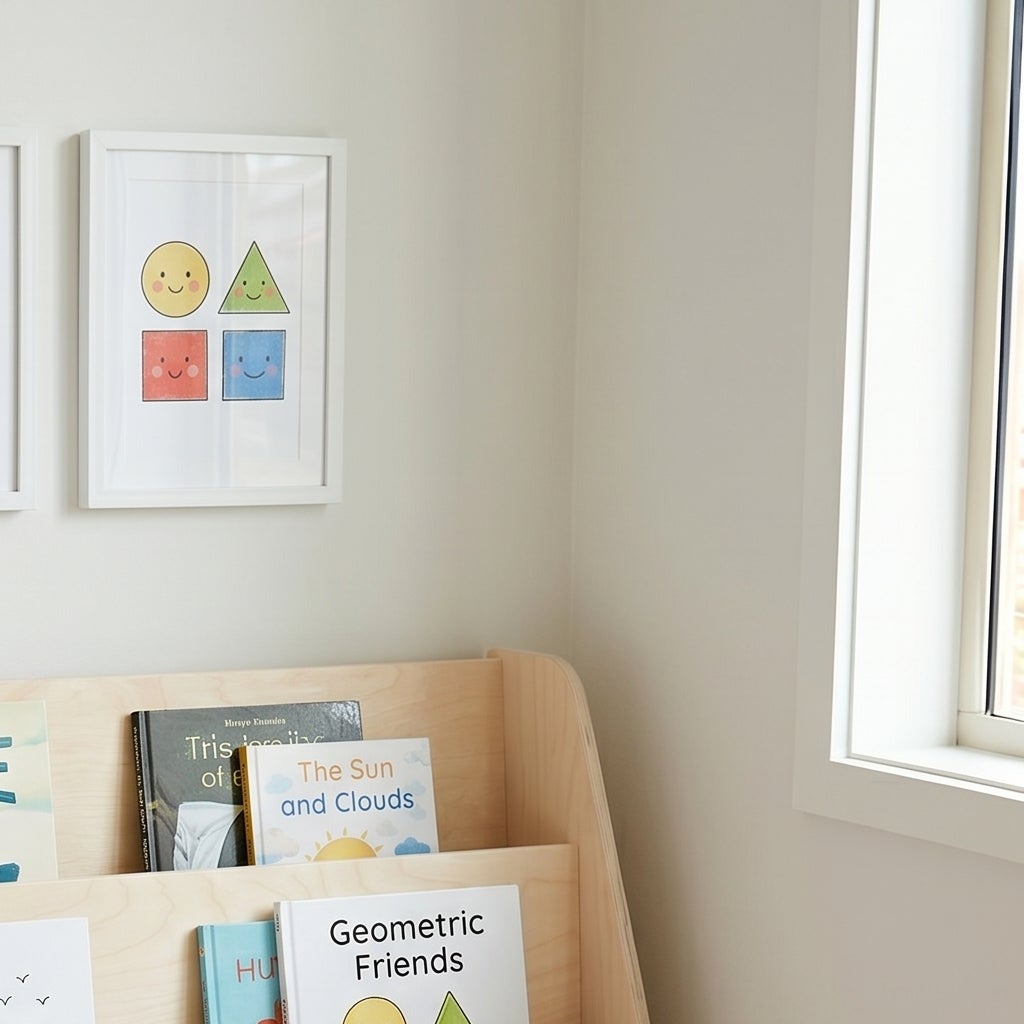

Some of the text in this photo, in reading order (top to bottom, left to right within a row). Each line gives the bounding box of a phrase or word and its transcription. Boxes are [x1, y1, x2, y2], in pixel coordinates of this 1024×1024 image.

[185, 733, 233, 760] Tris
[201, 765, 225, 788] of
[297, 758, 394, 783] The Sun
[281, 787, 415, 817] and Clouds
[329, 909, 486, 946] Geometric
[236, 956, 279, 983] HU
[355, 946, 465, 981] Friends
